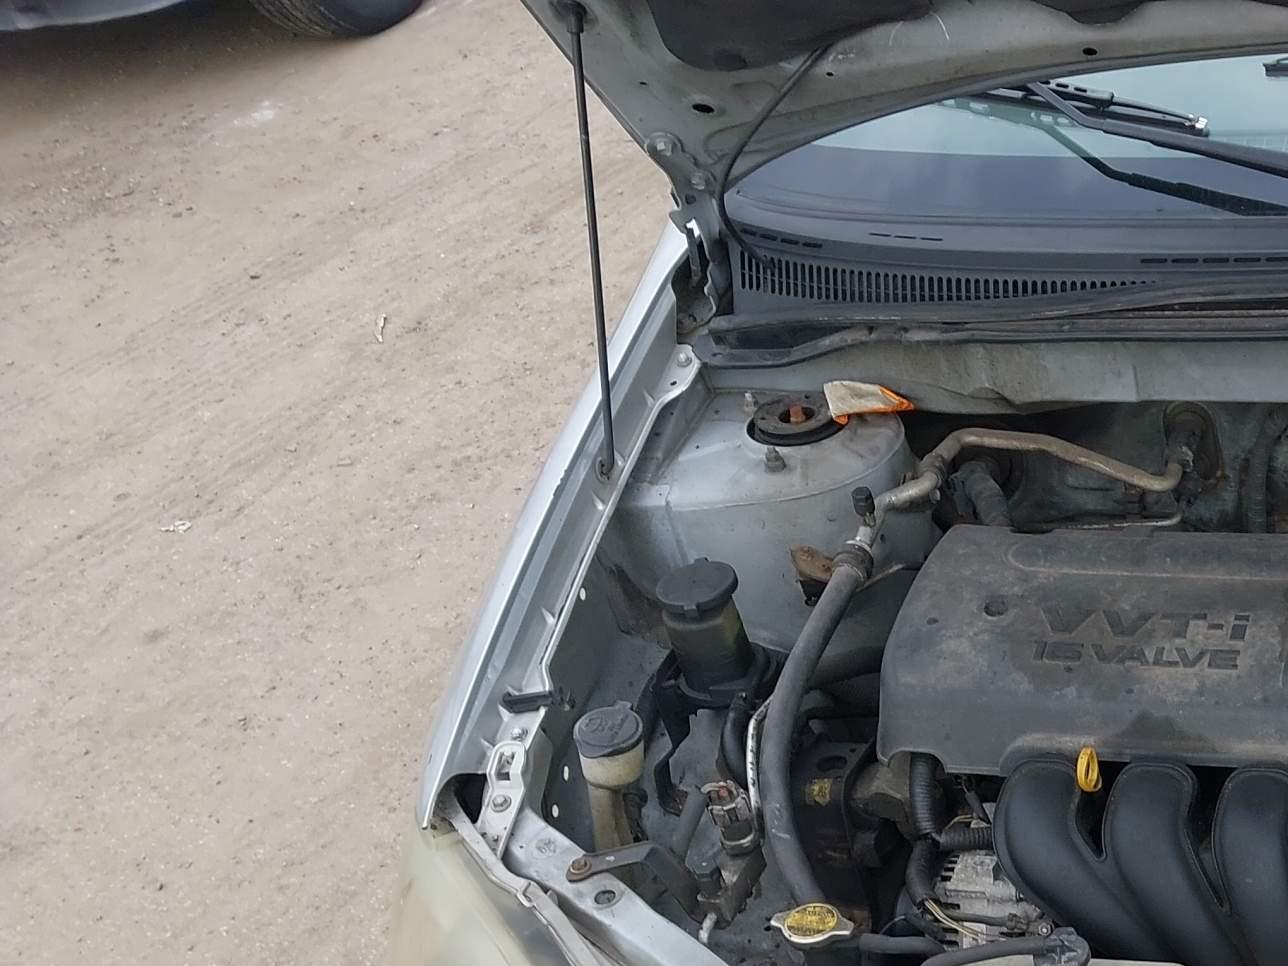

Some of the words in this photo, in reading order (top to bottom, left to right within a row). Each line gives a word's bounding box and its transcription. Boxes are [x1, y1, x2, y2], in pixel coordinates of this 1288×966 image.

[1040, 606, 1251, 642] VVT-i
[1032, 639, 1085, 663] 16
[1091, 643, 1241, 671] VALVE
